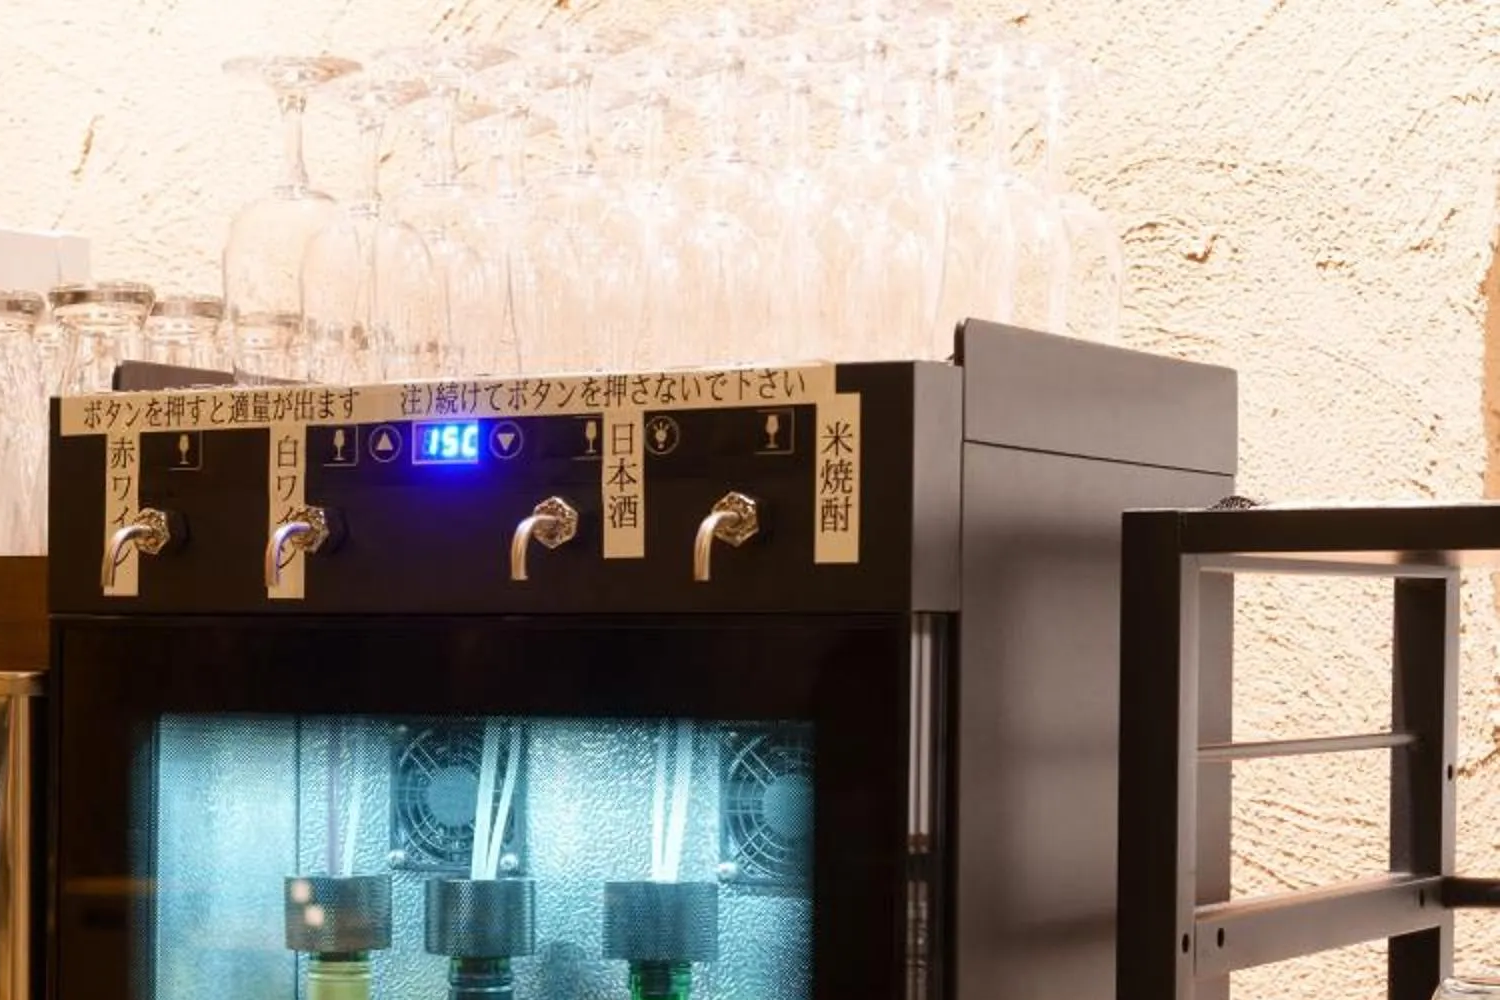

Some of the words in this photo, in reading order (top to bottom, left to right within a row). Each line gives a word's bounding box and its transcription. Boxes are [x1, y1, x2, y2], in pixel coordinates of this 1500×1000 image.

[84, 389, 360, 429] ボタンを押すと適量が出ます
[607, 422, 639, 530] 日本酒
[820, 421, 853, 533] 米焼酎
